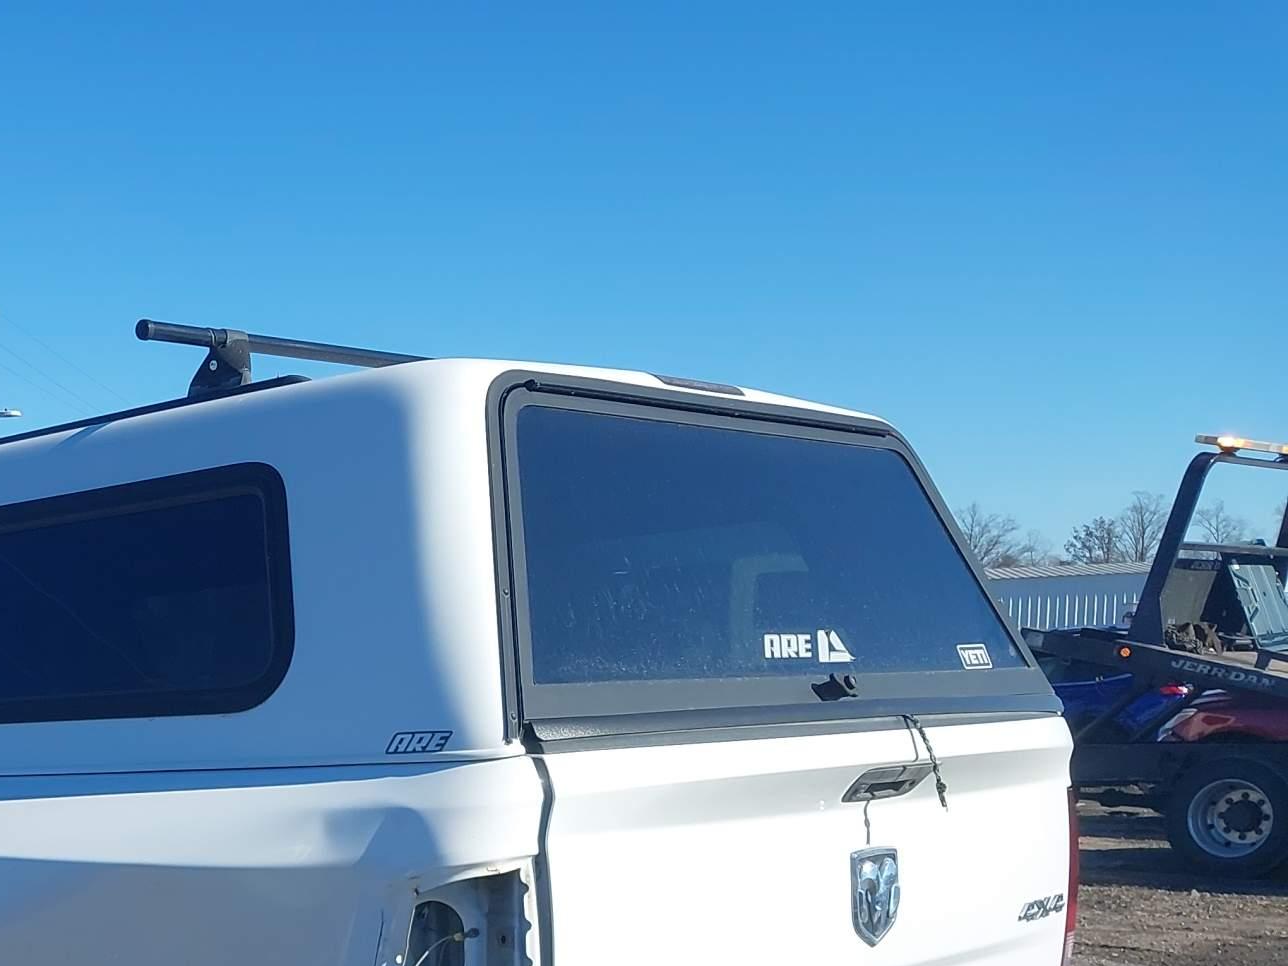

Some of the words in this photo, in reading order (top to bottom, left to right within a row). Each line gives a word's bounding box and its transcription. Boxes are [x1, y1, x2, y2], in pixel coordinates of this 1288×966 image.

[764, 633, 812, 659] ARE
[961, 649, 989, 665] YETI
[386, 731, 452, 754] ARE
